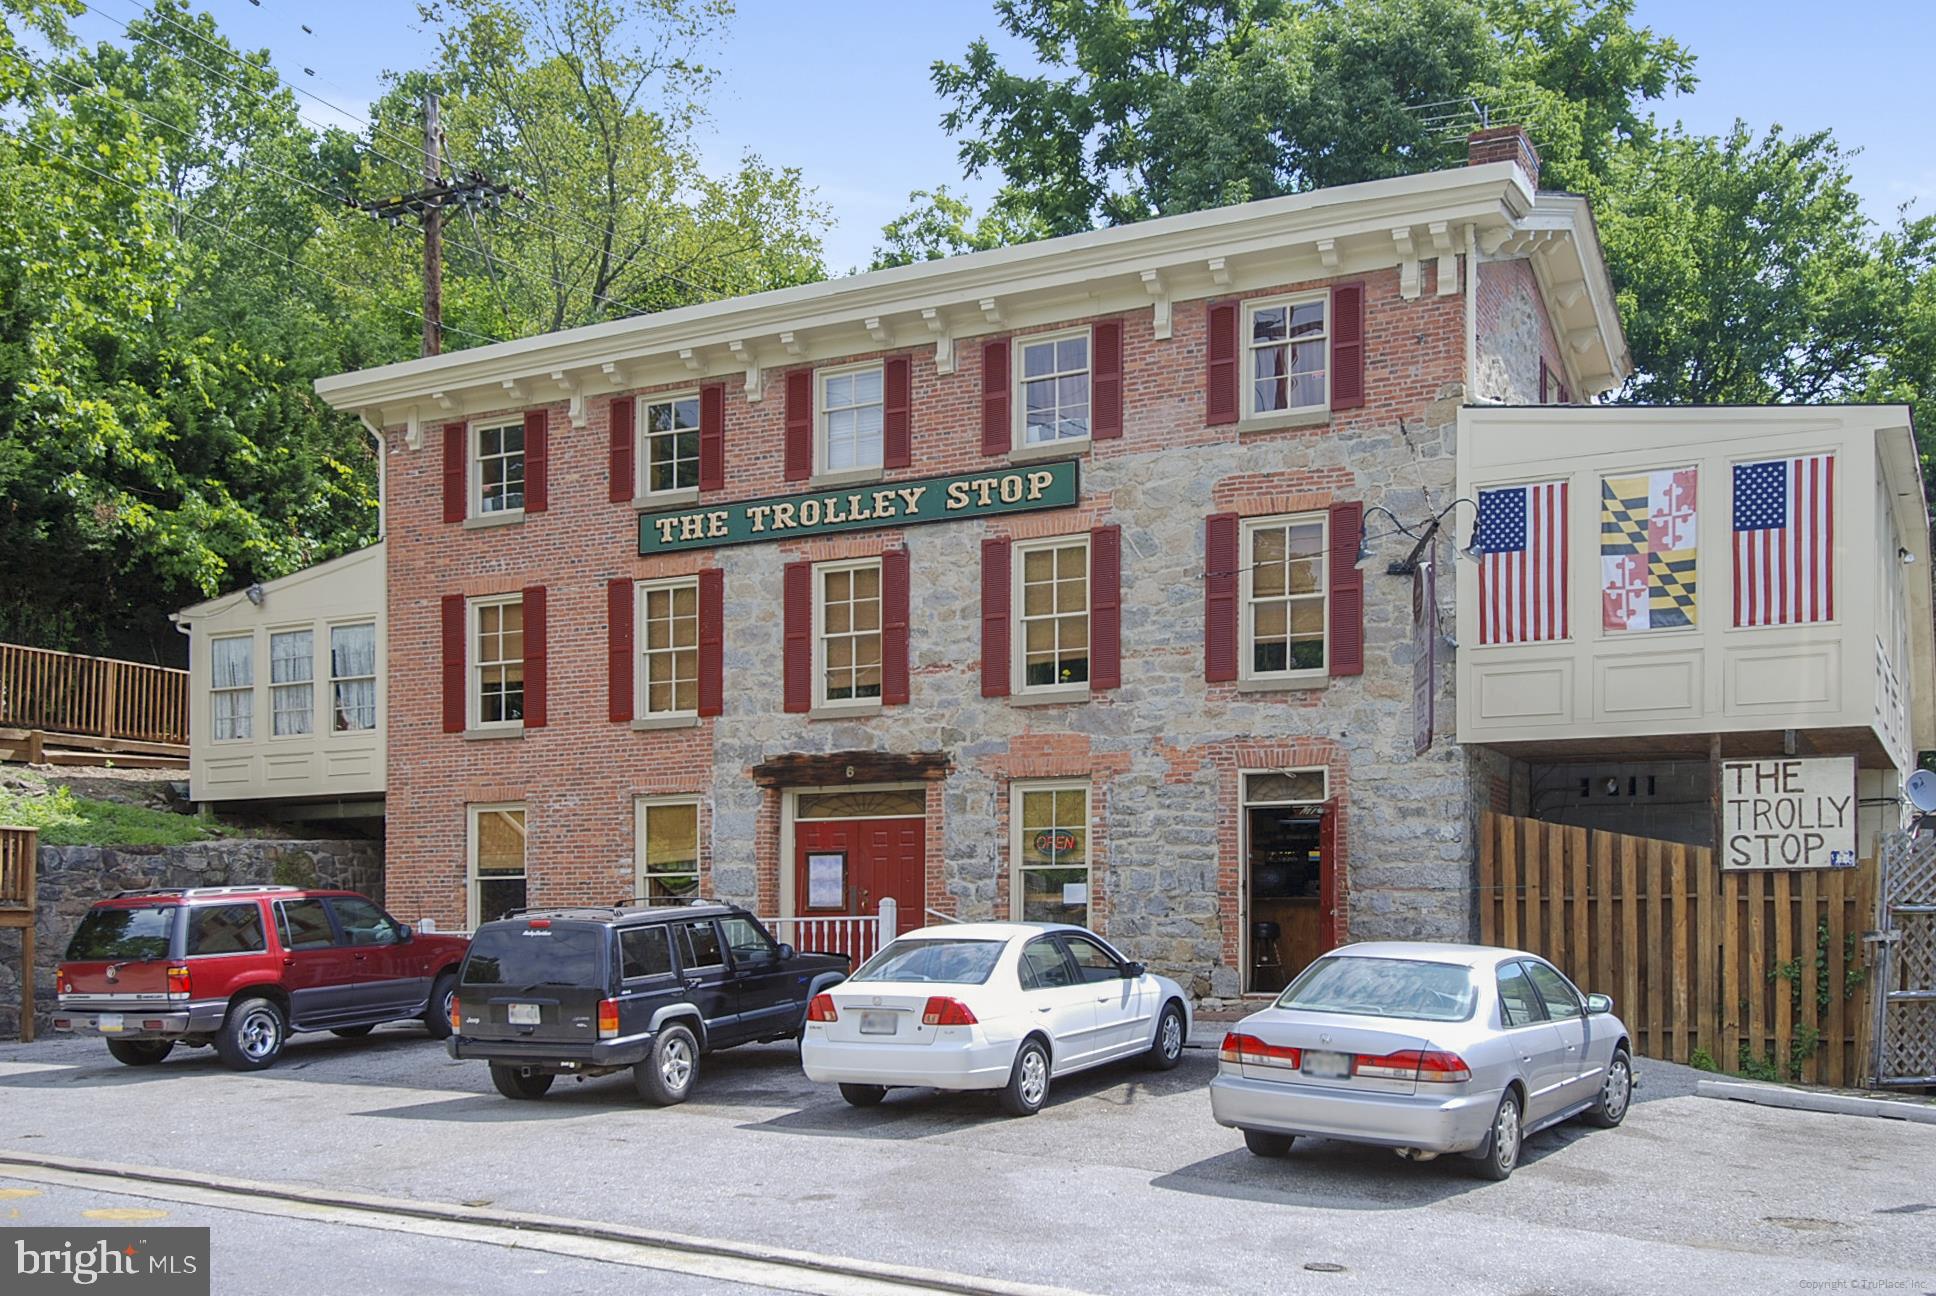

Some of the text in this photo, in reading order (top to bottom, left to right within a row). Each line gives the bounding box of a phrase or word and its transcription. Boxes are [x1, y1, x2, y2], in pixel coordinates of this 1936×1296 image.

[655, 471, 1054, 543] THE TROLLEY STOP
[1725, 761, 1805, 794] THE
[1727, 796, 1851, 831] TROLLY
[1036, 835, 1075, 849] OPEN
[1729, 833, 1825, 866] STOP
